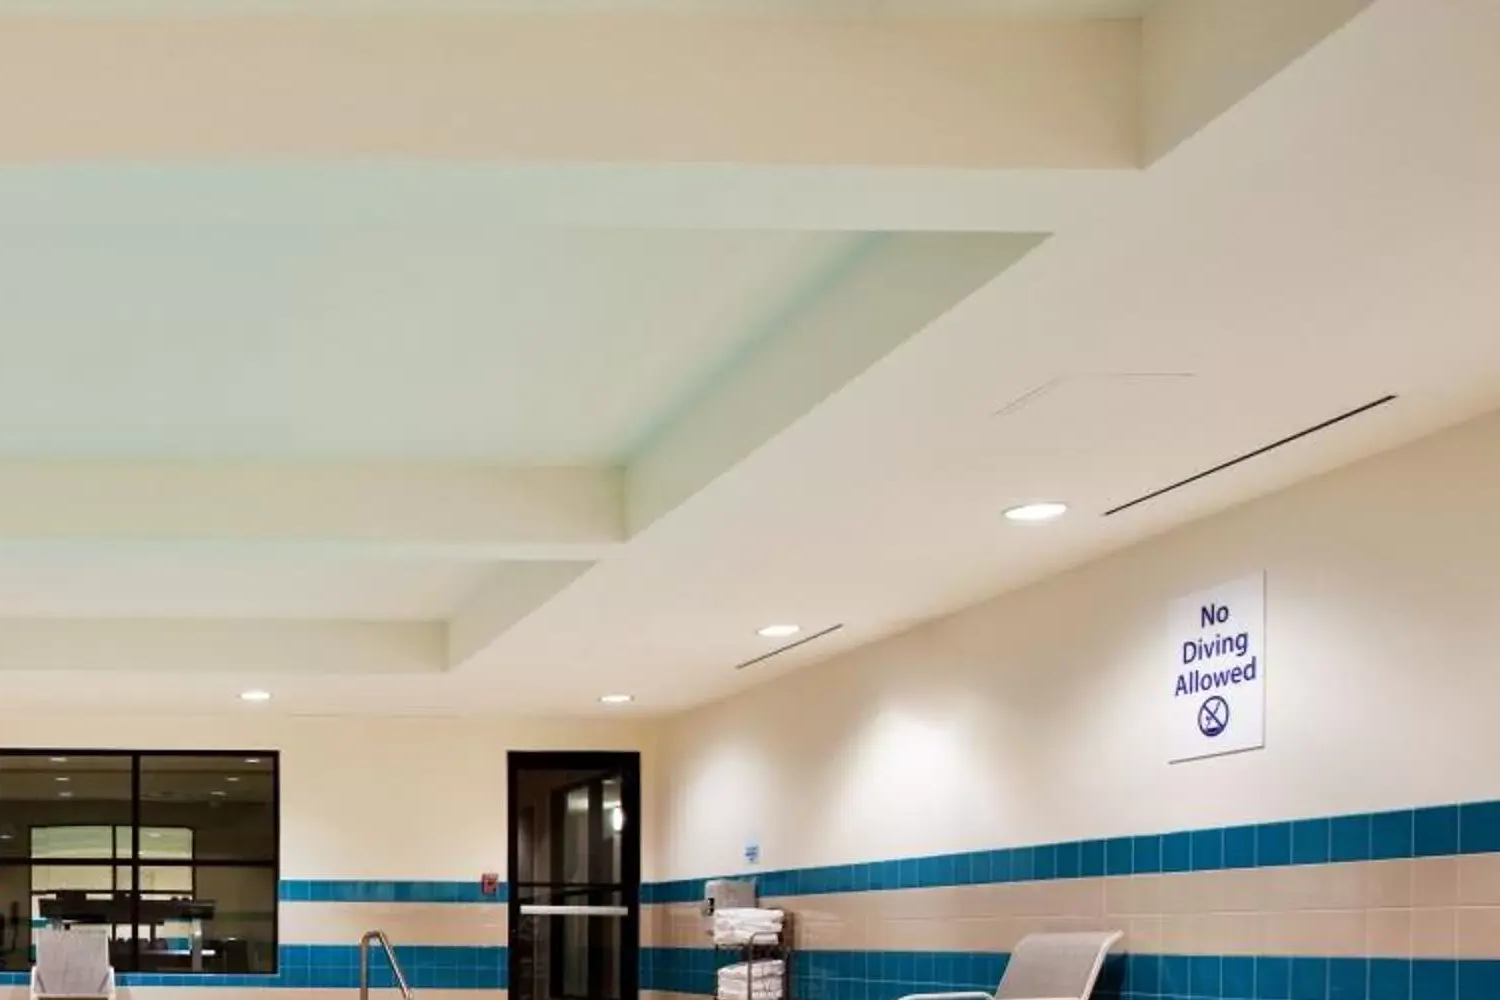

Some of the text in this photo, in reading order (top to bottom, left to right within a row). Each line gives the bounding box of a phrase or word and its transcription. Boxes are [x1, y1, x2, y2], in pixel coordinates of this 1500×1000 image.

[1201, 604, 1229, 627] No
[1183, 632, 1248, 664] Diving
[1175, 656, 1256, 697] Allowed
